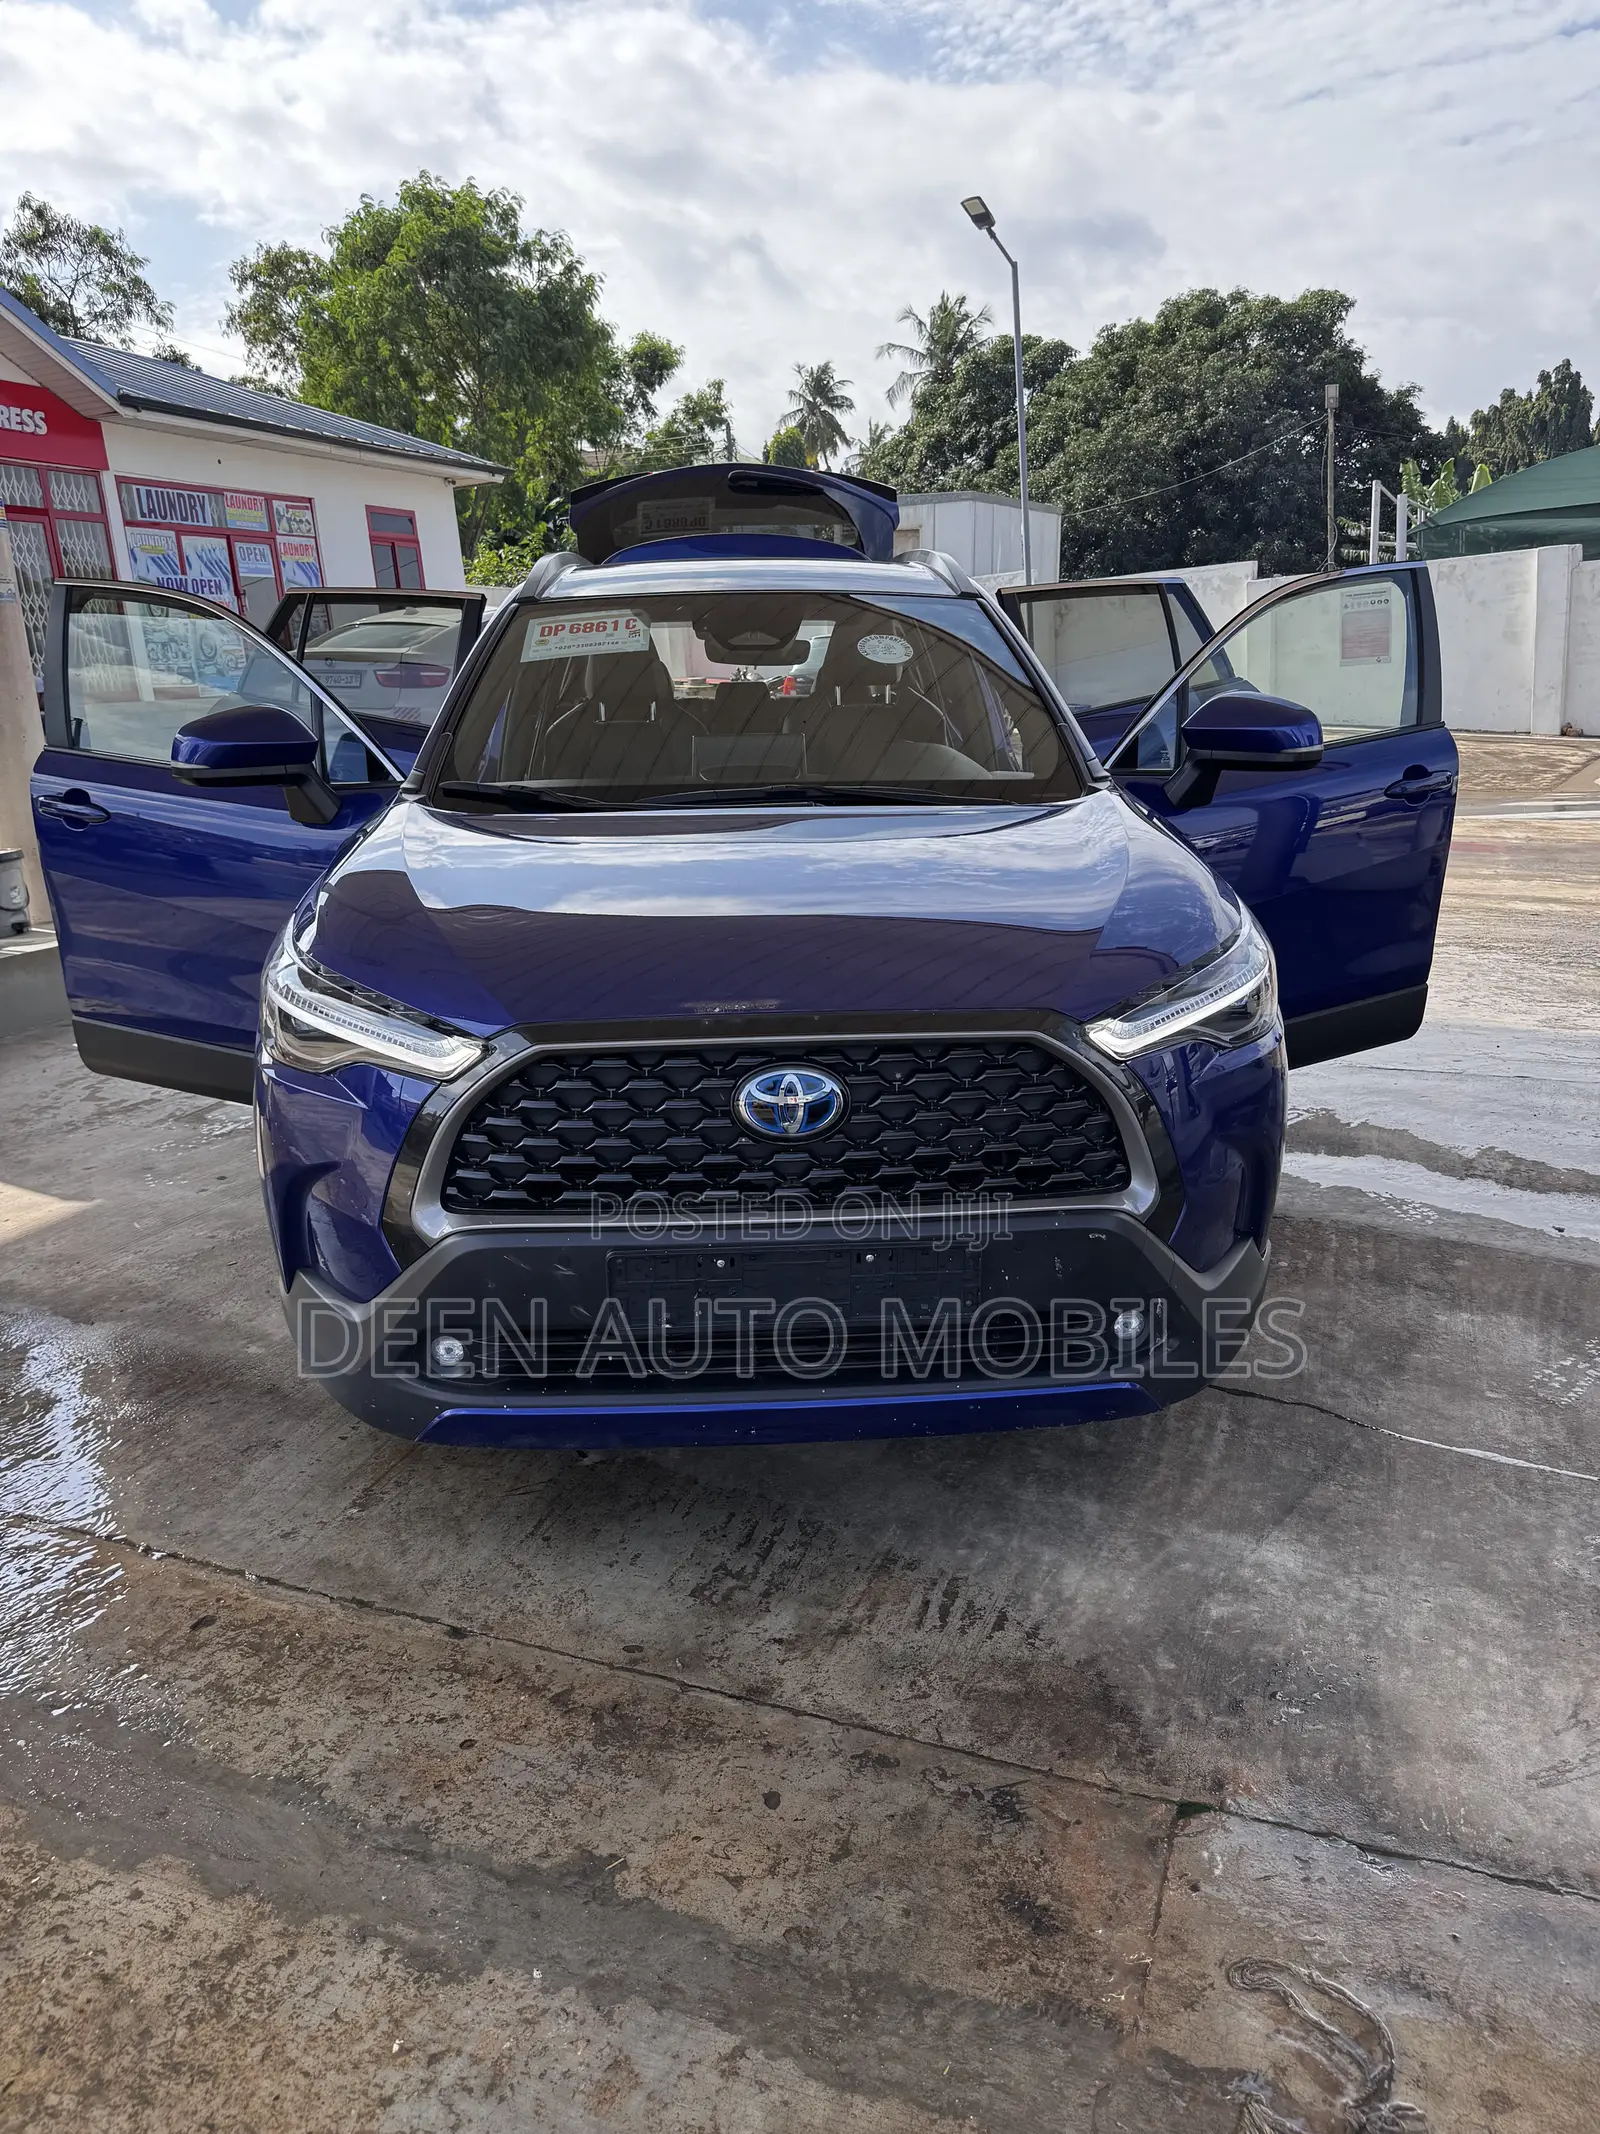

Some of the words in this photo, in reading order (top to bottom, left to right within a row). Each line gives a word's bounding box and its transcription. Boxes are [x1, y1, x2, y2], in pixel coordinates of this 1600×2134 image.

[0, 404, 47, 435] RESS
[135, 487, 207, 524] LAUNDRY
[224, 492, 265, 511] LAUNDRY
[130, 532, 174, 551] LAUNDRY
[279, 542, 314, 557] LAUNDRY
[238, 546, 267, 563] OPEN
[191, 578, 223, 595] OPEN
[540, 623, 566, 637] DP
[568, 620, 619, 634] 6861
[624, 618, 638, 630] C
